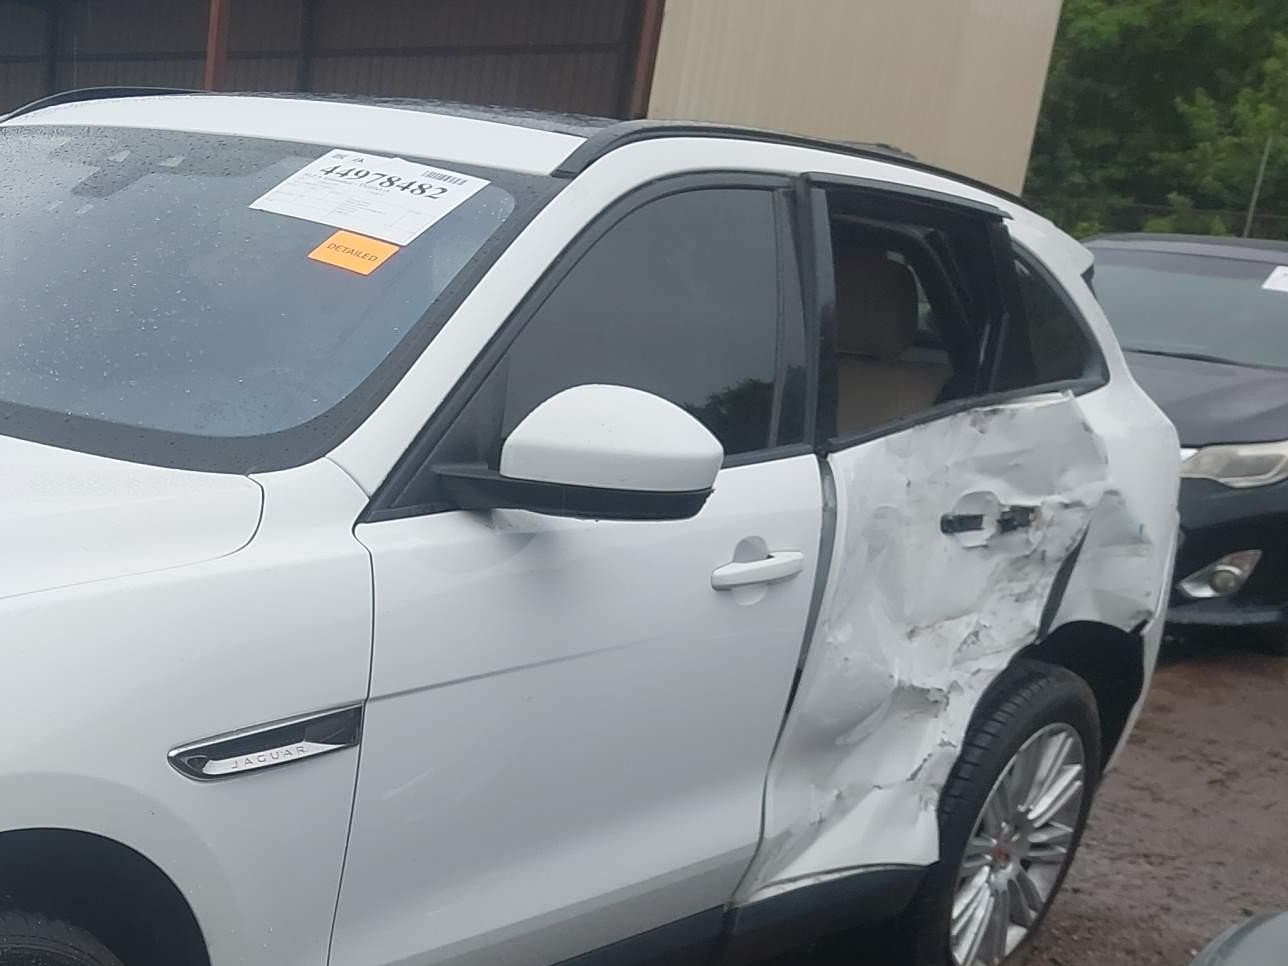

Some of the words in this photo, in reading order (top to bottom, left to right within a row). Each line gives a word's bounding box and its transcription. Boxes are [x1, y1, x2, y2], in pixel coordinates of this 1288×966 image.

[319, 164, 449, 200] 44978482
[325, 242, 379, 264] DETAILED
[230, 745, 306, 770] JAGUAR
